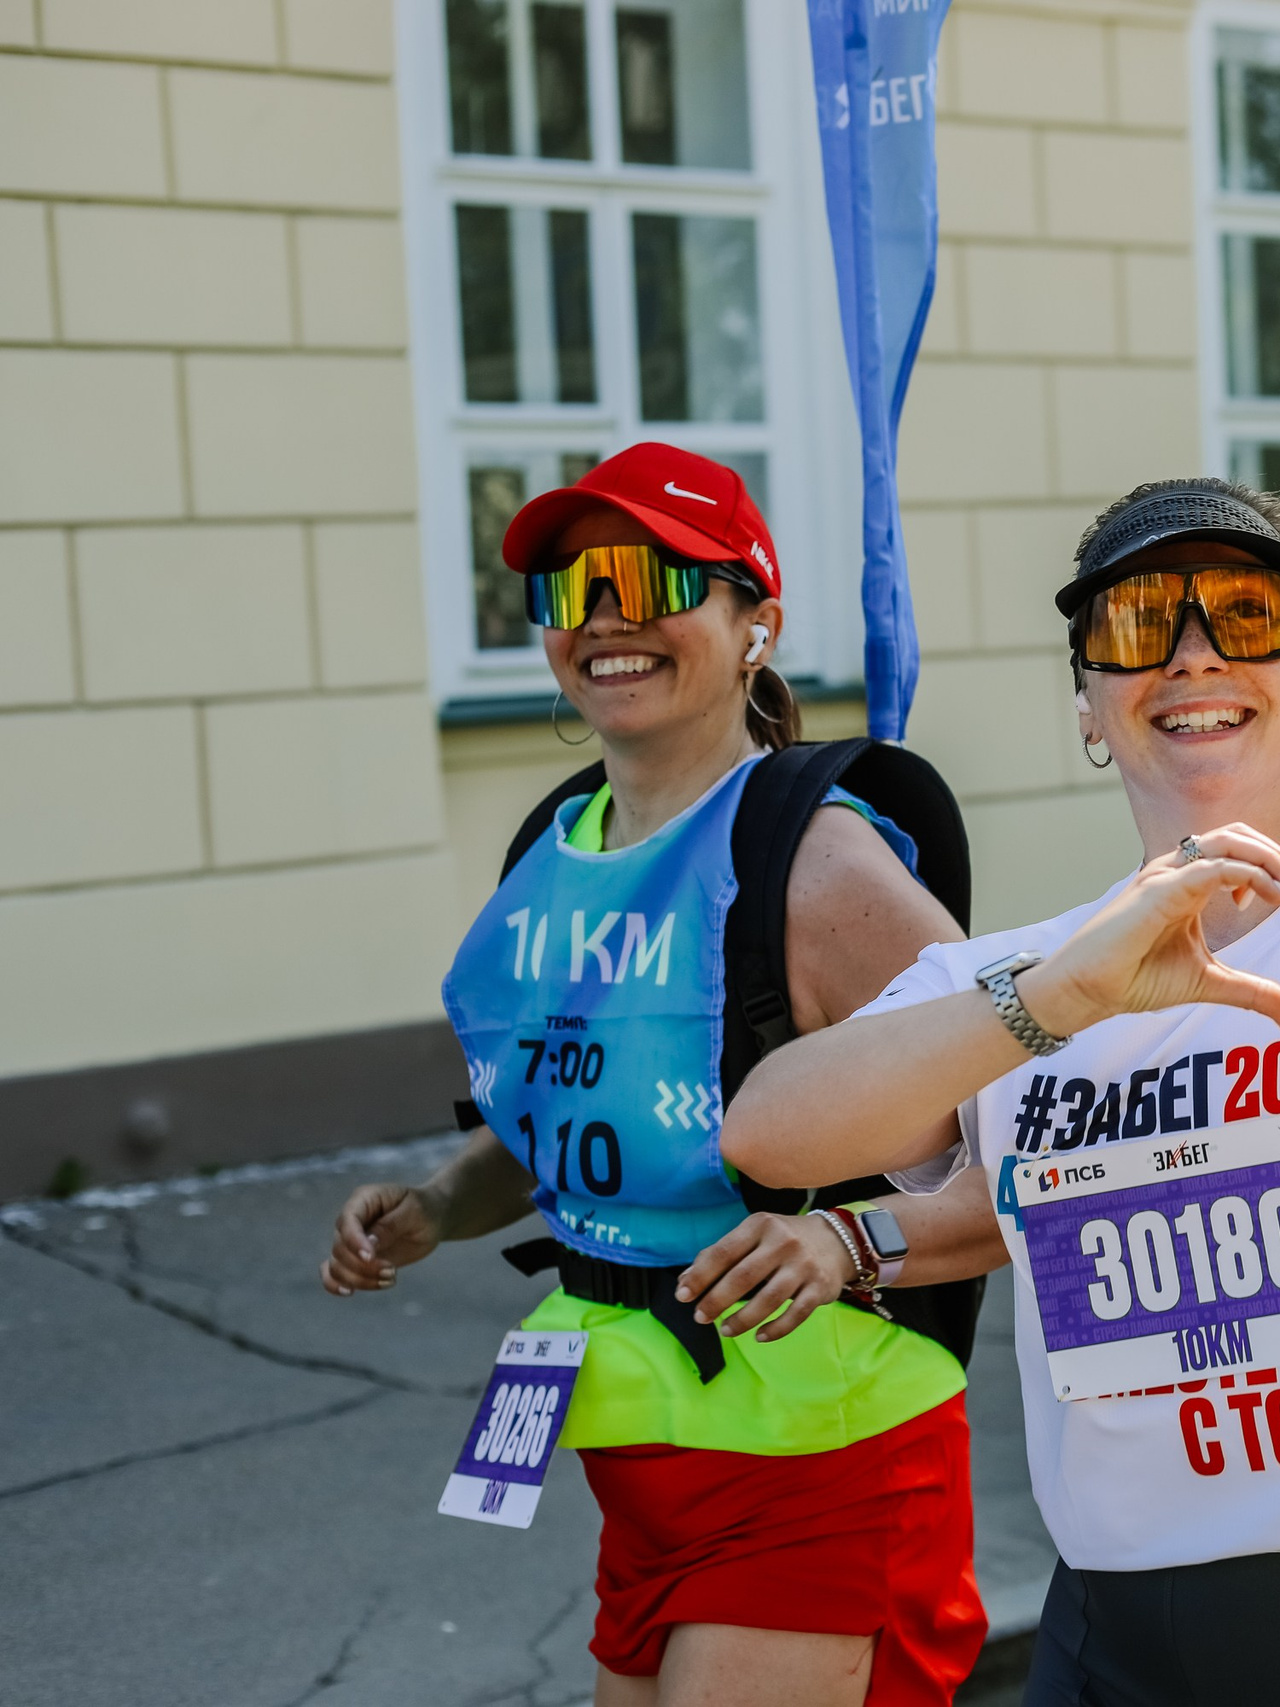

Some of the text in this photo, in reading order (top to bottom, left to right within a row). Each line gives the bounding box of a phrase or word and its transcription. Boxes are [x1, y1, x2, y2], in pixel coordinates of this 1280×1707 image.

[569, 909, 676, 986] КМ
[545, 1015, 588, 1031] ТЕМП:
[518, 1039, 604, 1089] 7:00
[1064, 1163, 1106, 1185] ПСБ
[1153, 1141, 1211, 1172] ЗАБЕГ
[1093, 1322, 1130, 1342] СТРЕСС
[1129, 1317, 1162, 1336] ДАВНО
[1162, 1311, 1199, 1331] ОТСТАЛ
[1215, 1300, 1264, 1322] ВЫБЕГАЮ
[474, 1382, 560, 1468] 30266
